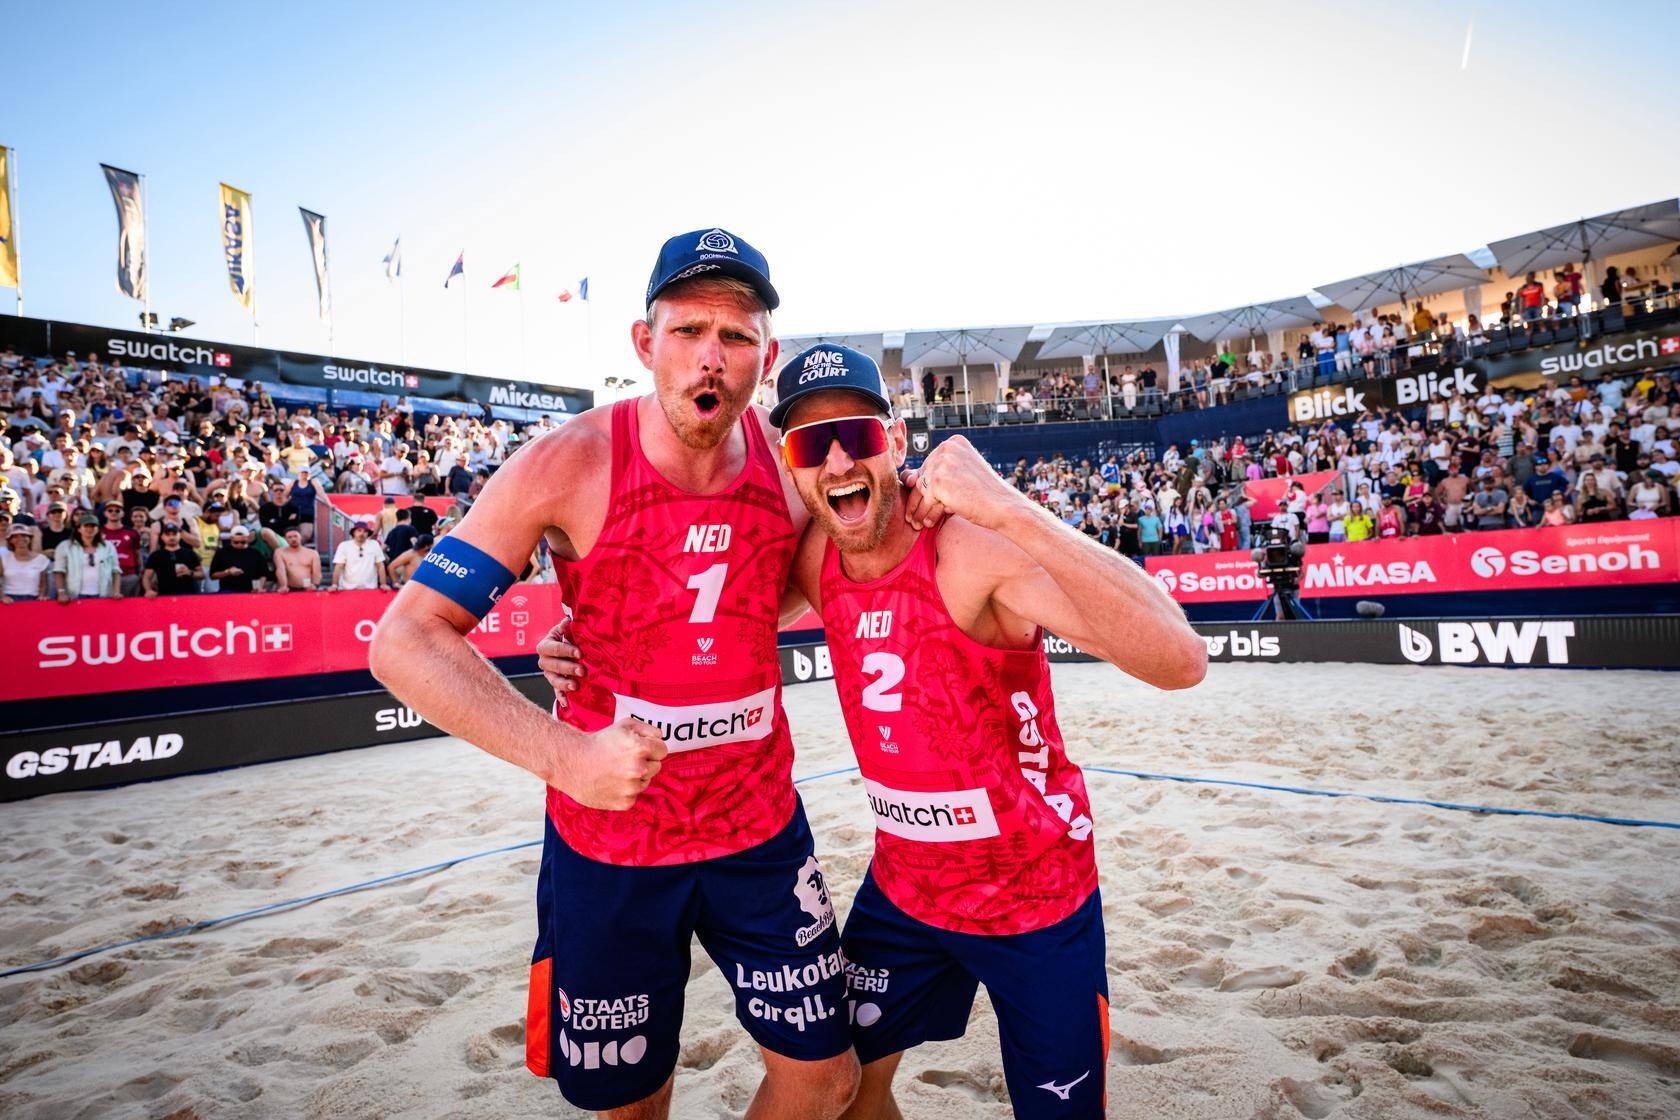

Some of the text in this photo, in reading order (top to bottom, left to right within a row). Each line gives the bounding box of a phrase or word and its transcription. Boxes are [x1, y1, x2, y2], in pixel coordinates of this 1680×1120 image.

[107, 338, 214, 366] swatch
[804, 349, 843, 368] KING
[1540, 338, 1658, 375] swatch
[323, 365, 405, 387] swatch
[799, 367, 849, 385] COURT
[1395, 368, 1479, 405] Blick
[1294, 388, 1367, 421] Blick
[683, 523, 732, 553] NED
[1566, 533, 1649, 547] Sports Equipment
[1510, 544, 1660, 575] Senoh
[686, 563, 729, 623] 1
[855, 610, 893, 639] NED
[38, 620, 257, 668] swatch
[1230, 630, 1281, 656] bls
[1438, 621, 1575, 664] BWT
[861, 652, 906, 712] 2
[5, 733, 184, 780] GSTAAD
[1010, 691, 1093, 841] GSTAAD
[868, 793, 954, 827] watch
[573, 994, 649, 1015] STAATS
[573, 1006, 649, 1031] LOTERIJ
